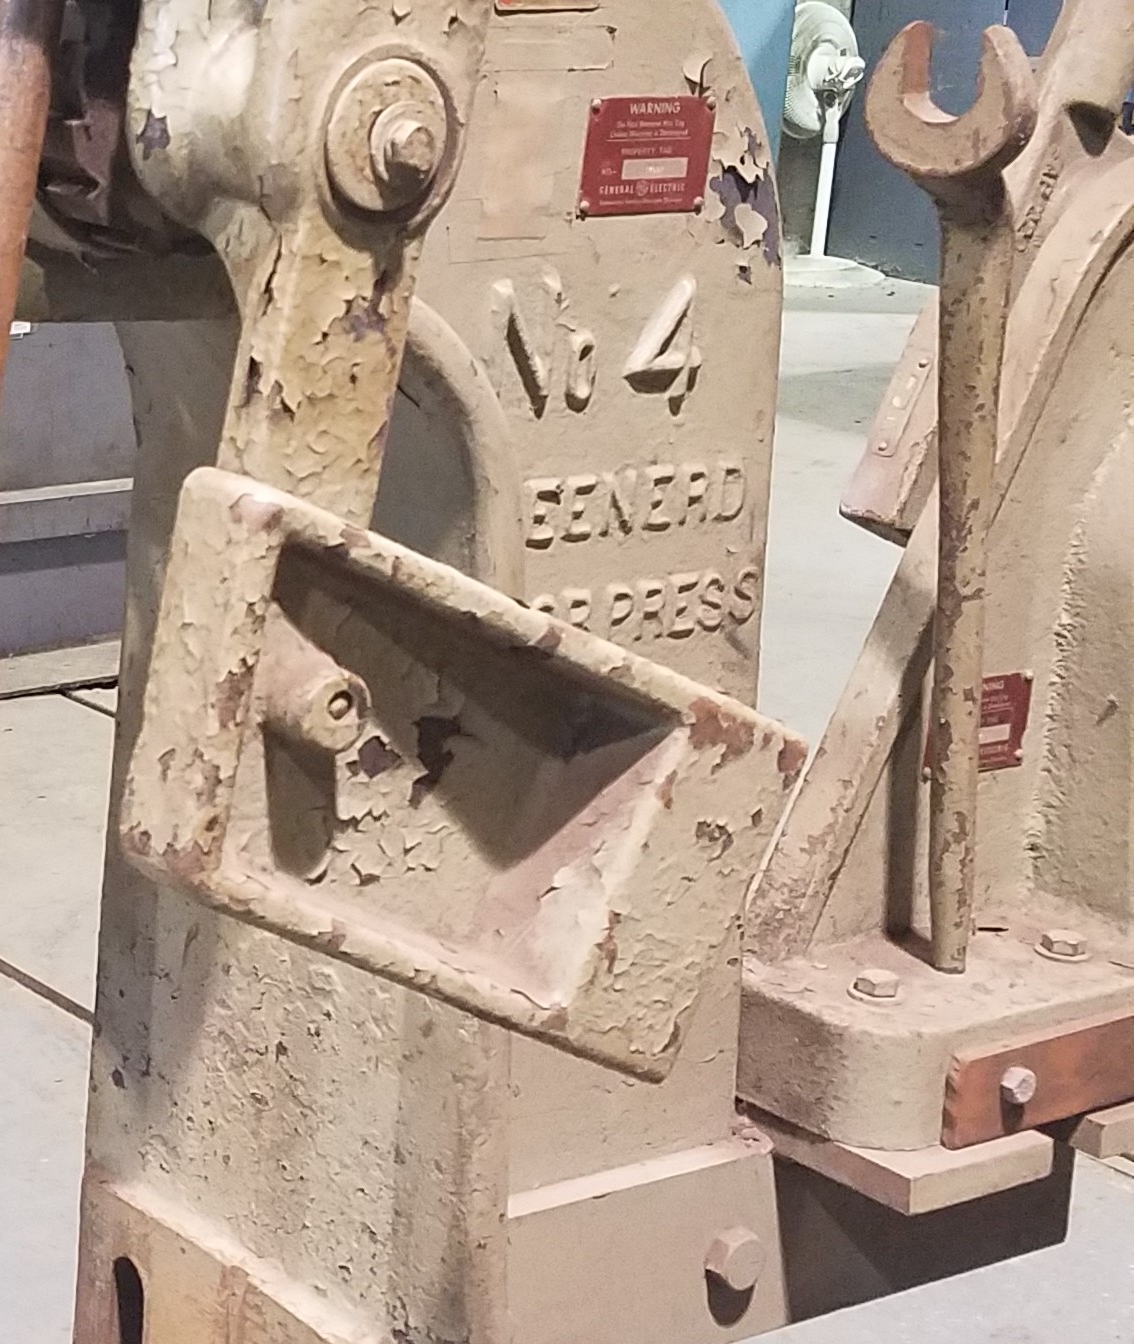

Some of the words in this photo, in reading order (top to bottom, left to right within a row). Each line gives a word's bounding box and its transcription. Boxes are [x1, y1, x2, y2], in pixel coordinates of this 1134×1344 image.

[629, 102, 681, 115] WARNING
[623, 271, 703, 418] 4
[607, 567, 759, 642] PRESS
